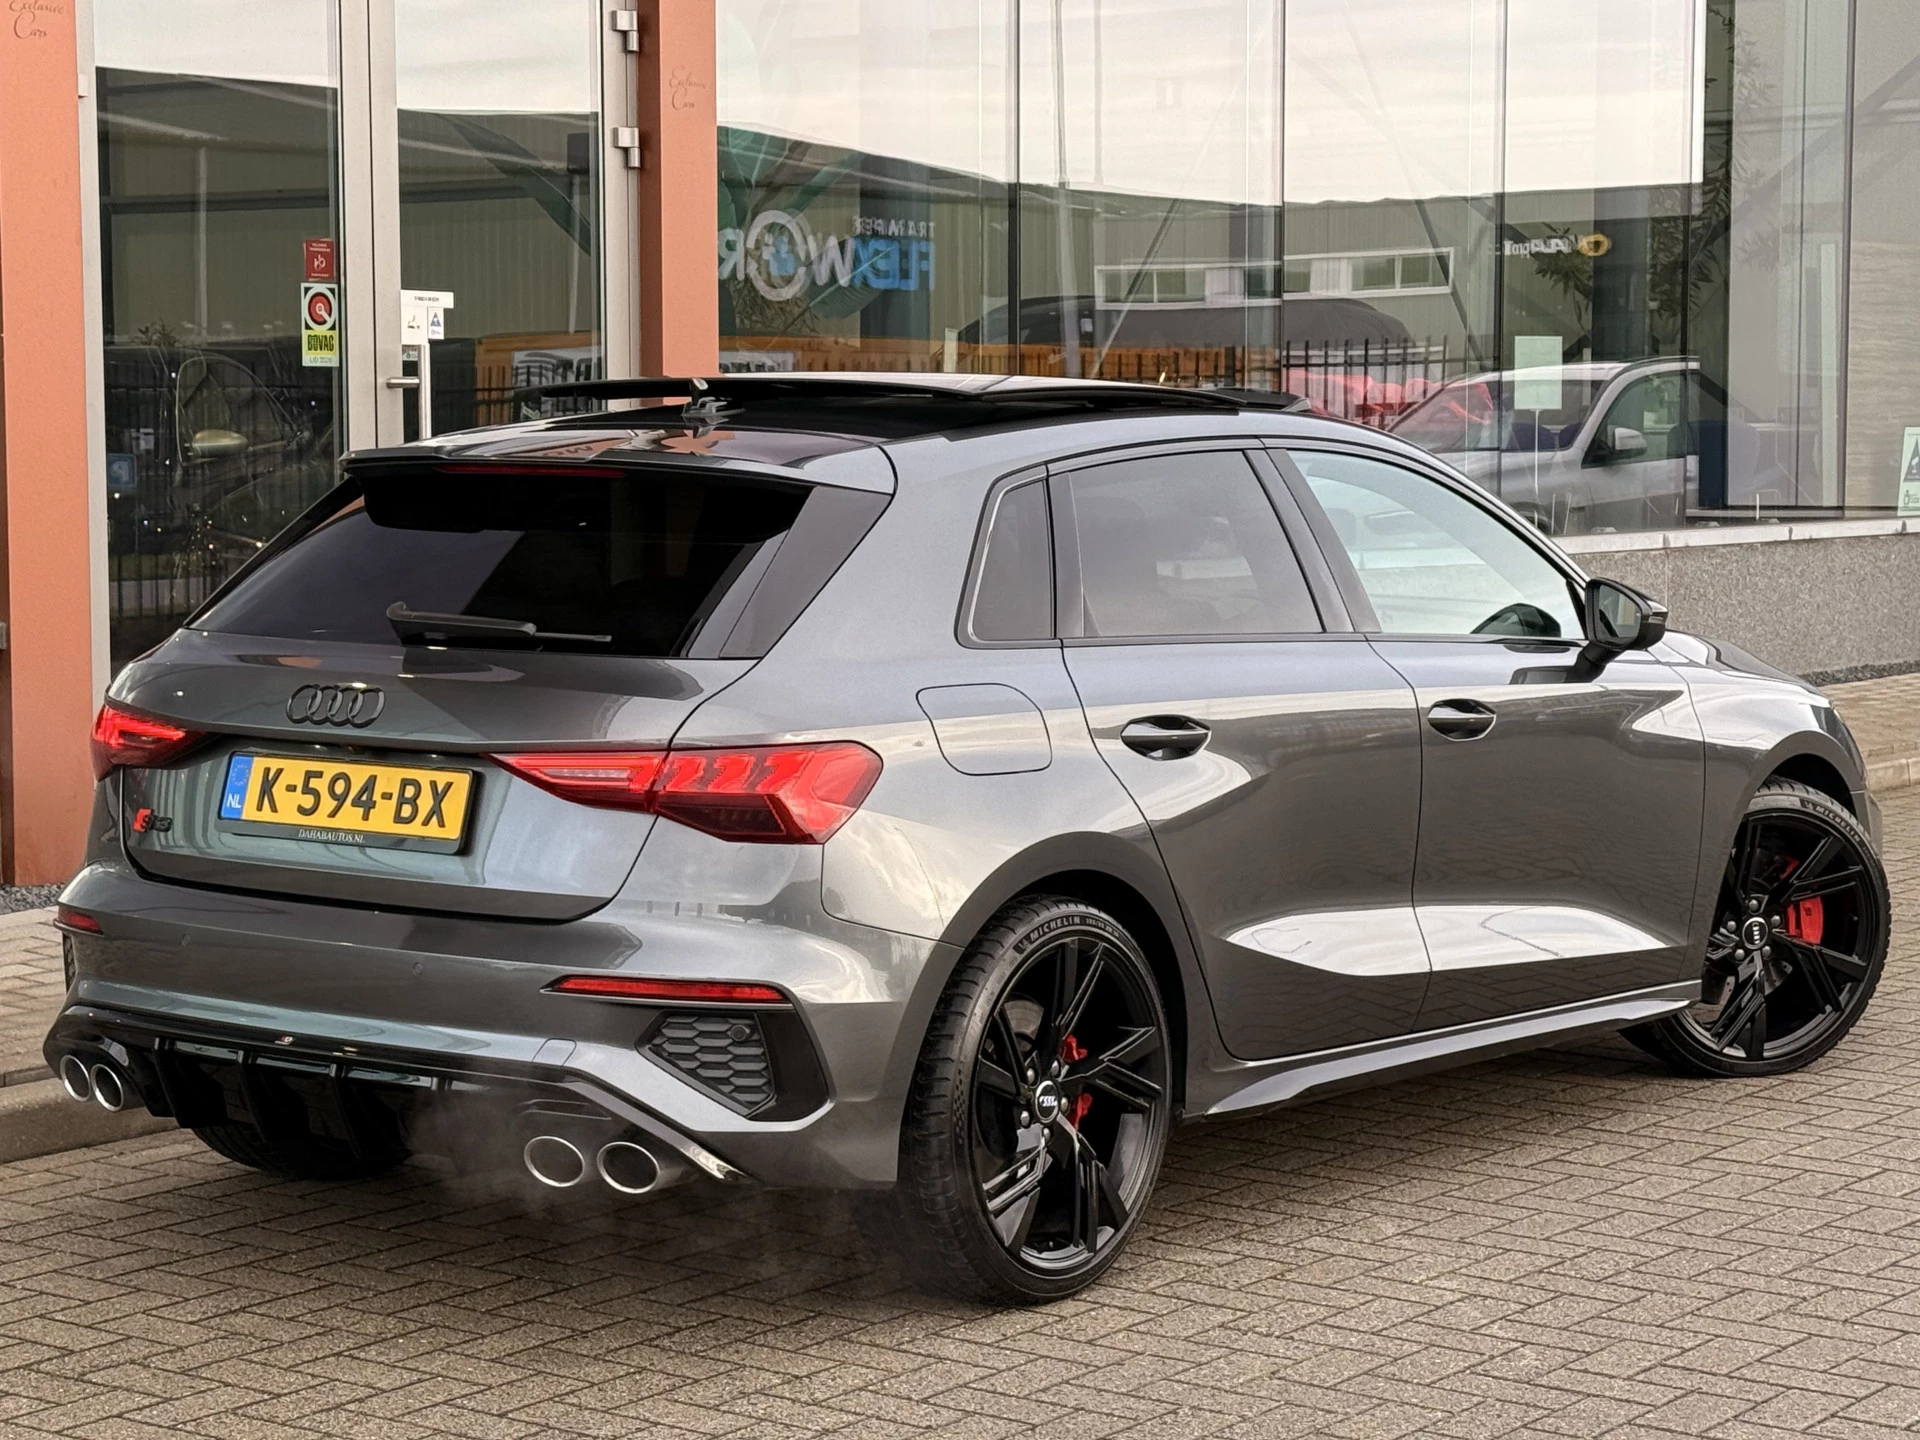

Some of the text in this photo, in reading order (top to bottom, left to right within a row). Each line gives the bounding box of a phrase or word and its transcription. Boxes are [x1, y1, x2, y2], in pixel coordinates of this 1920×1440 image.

[226, 793, 242, 809] NL
[256, 766, 453, 828] K-594-BX
[298, 828, 365, 844] DAHABAUTOS.NL
[1814, 806, 1861, 842] MICHELIN
[1029, 915, 1081, 943] MICHELIN
